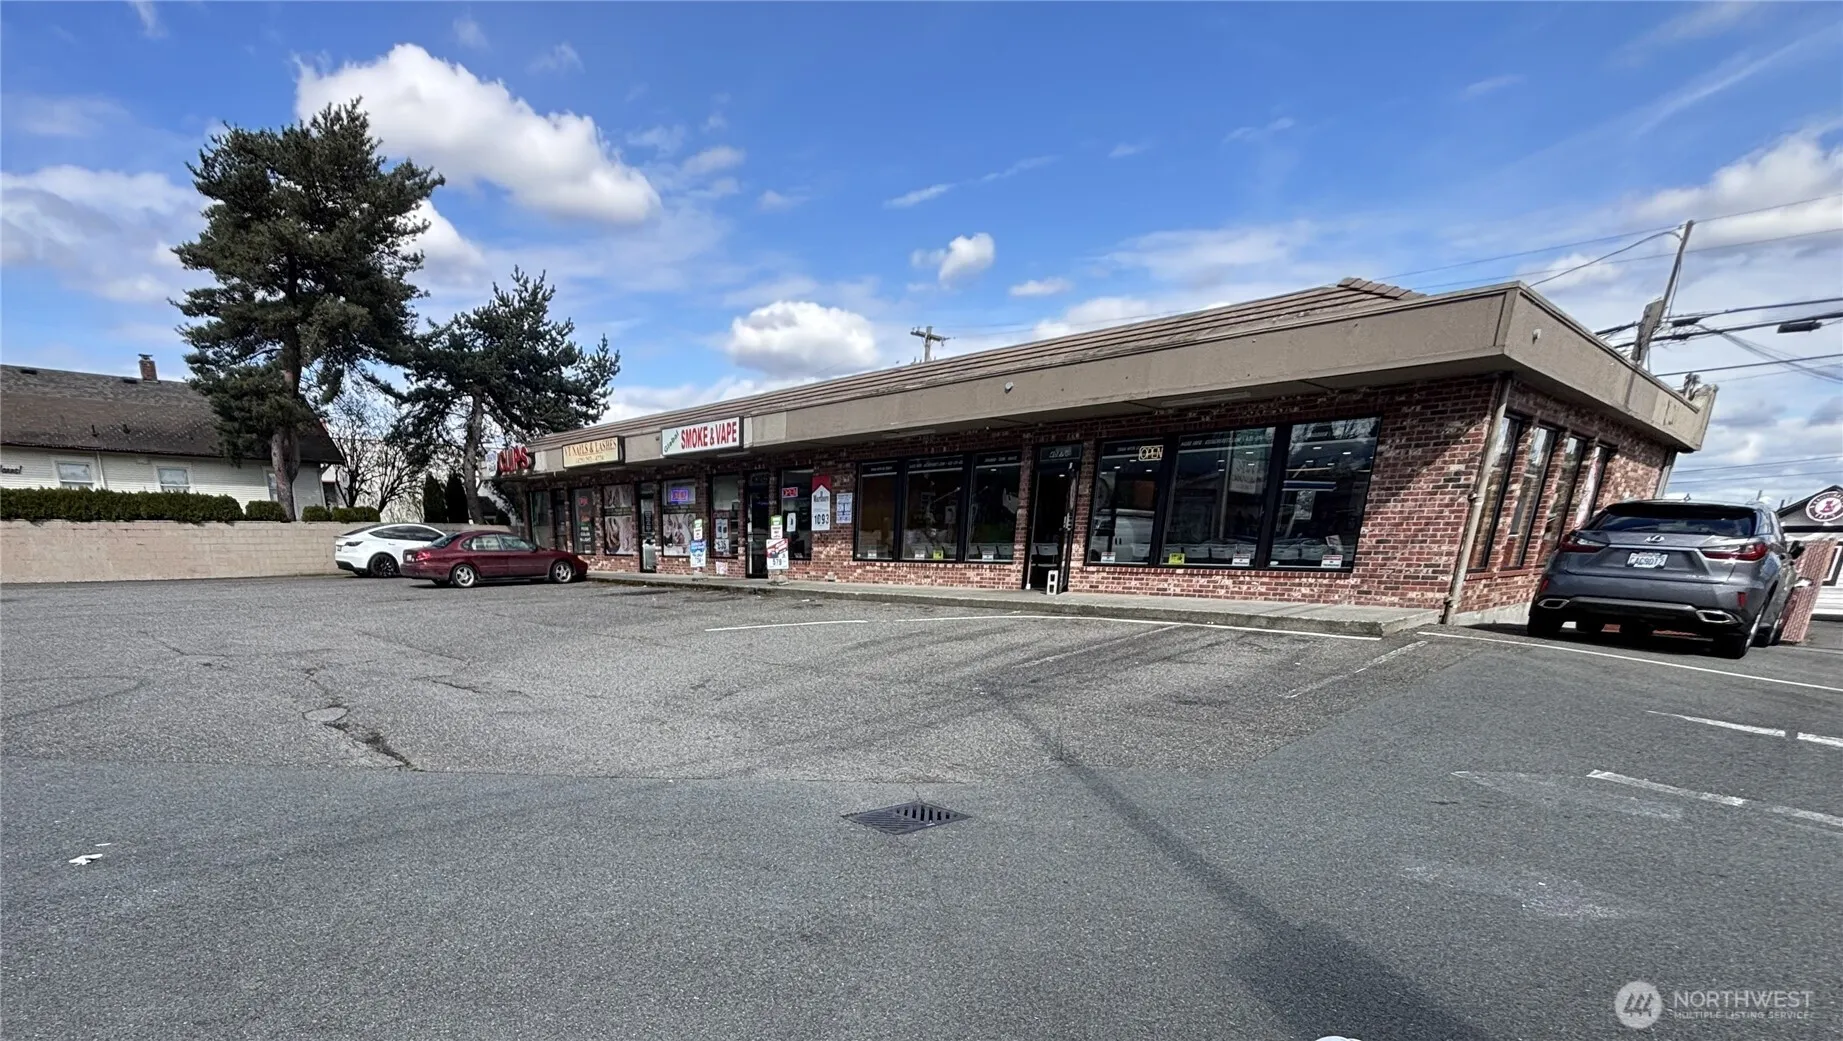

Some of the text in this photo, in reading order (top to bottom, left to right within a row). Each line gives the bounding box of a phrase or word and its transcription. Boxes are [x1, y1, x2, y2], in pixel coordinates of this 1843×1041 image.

[681, 421, 737, 449] SMOKE & VAPE
[595, 439, 617, 452] LASHES
[1140, 446, 1163, 460] OPEN
